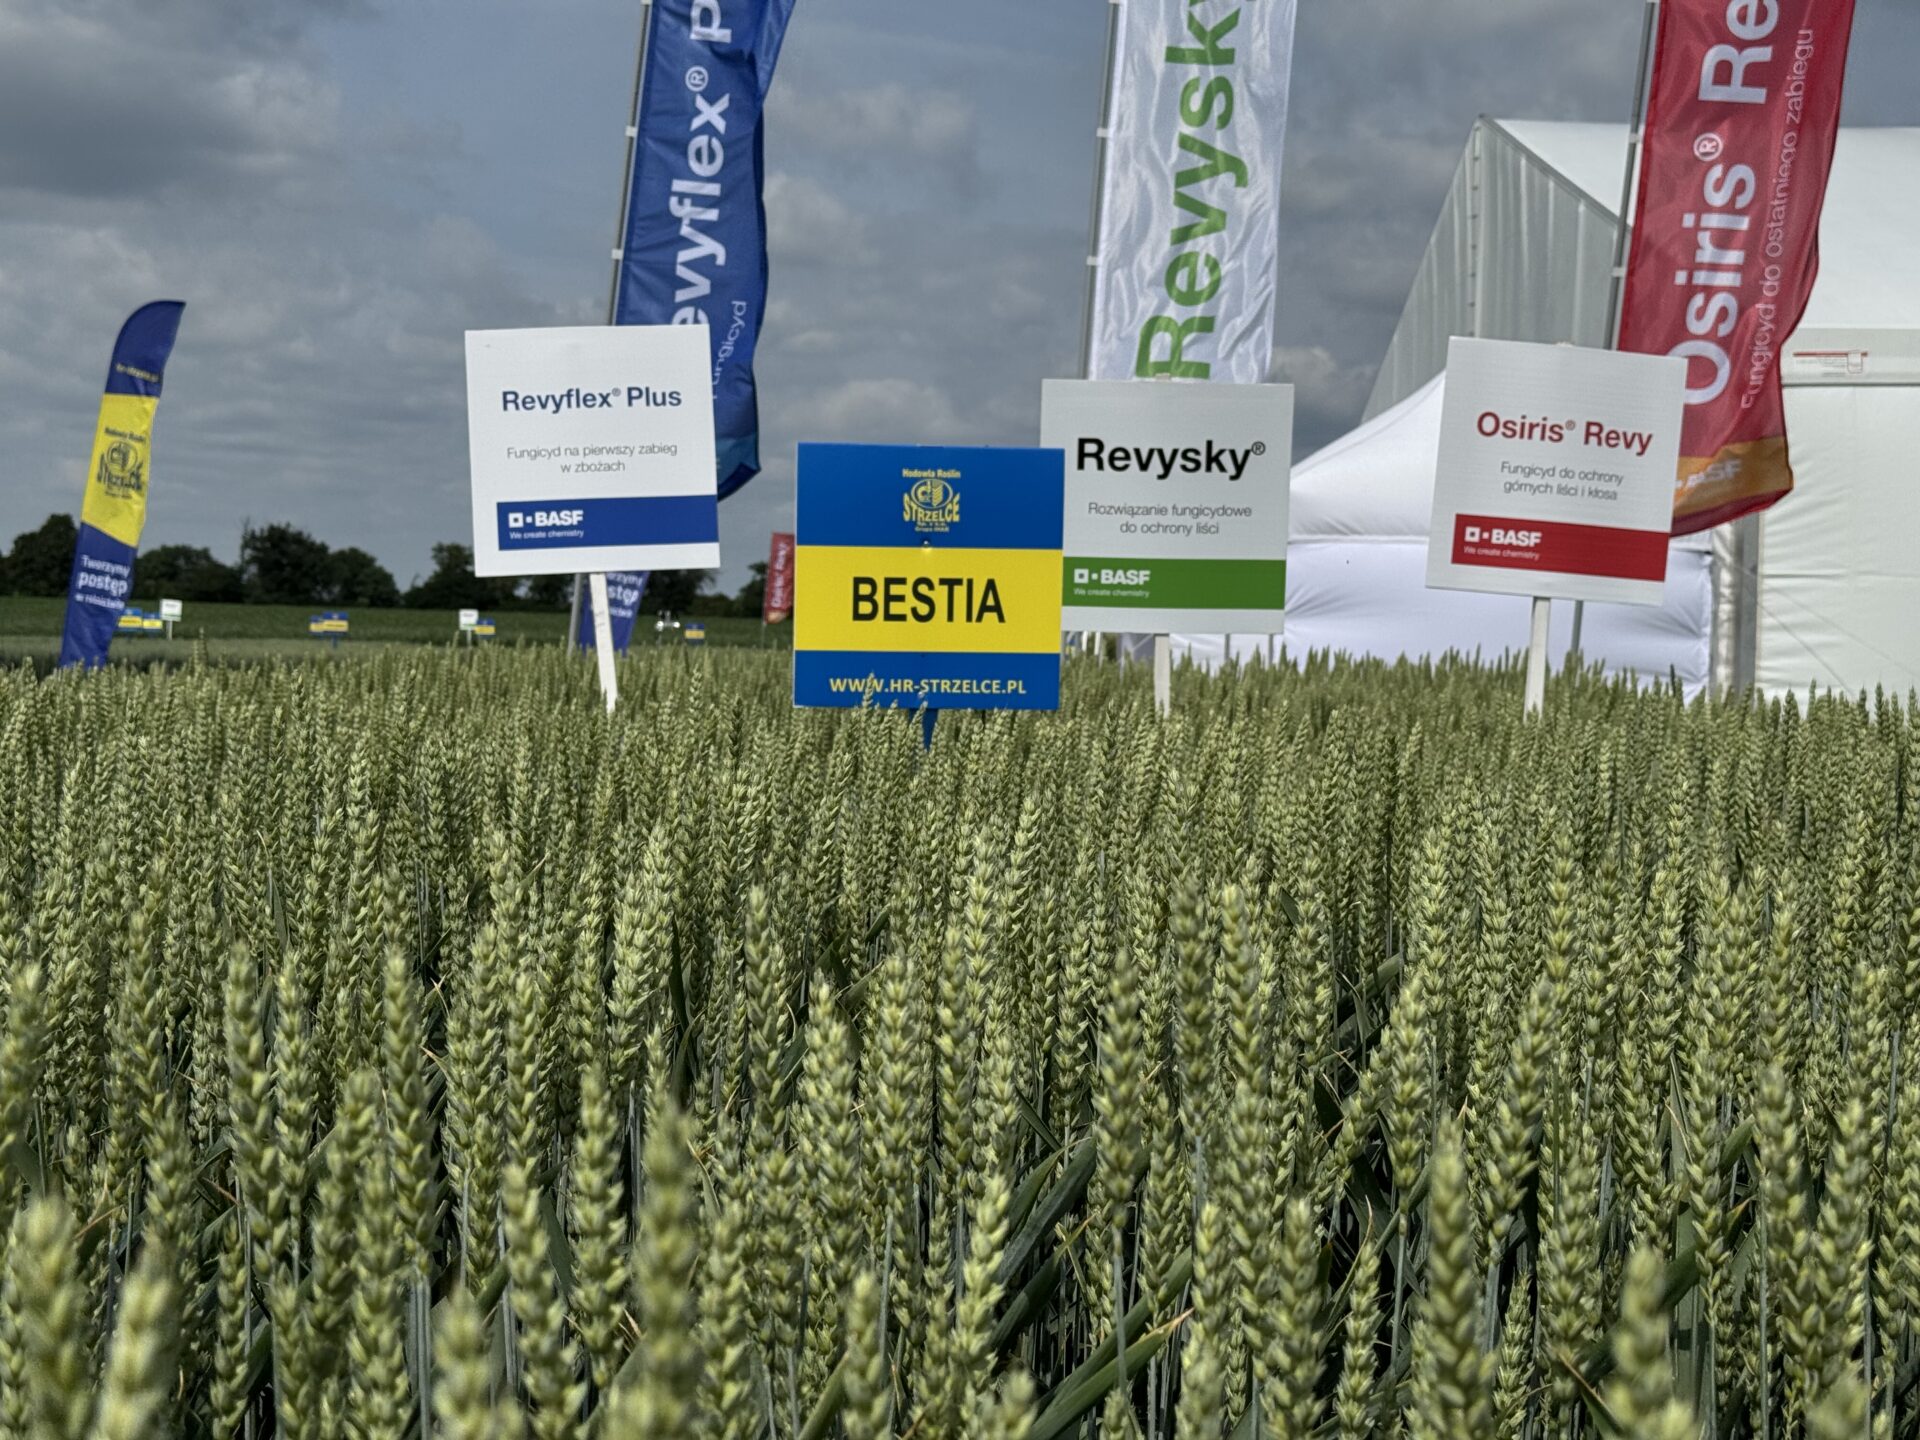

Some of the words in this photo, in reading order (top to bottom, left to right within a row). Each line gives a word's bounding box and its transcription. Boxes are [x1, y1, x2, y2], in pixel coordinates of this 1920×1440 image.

[1698, 0, 1779, 104] Re
[1784, 28, 1814, 124] zabiegu
[668, 66, 730, 325] vyflex®
[1135, 0, 1249, 379] Revysk
[1765, 131, 1797, 258] ostatniego
[1759, 264, 1780, 297] do
[502, 388, 621, 413] Revyflex®
[627, 386, 682, 407] Plus
[1477, 412, 1577, 443] Osiris®
[1583, 421, 1653, 456] Revy
[507, 445, 562, 461] Fungicyd
[564, 447, 580, 457] na
[583, 443, 636, 458] pierwszy
[638, 442, 678, 457] zabieg
[1077, 438, 1266, 481] Revysky®
[560, 463, 571, 474] w
[1501, 461, 1556, 480] Fungicyd
[1559, 467, 1575, 480] do
[1578, 470, 1624, 487] ochrony
[1503, 480, 1554, 497] górnych
[1556, 483, 1578, 497] liści
[534, 509, 584, 527] BASF
[903, 492, 960, 522] STRZELCE
[1088, 502, 1168, 519] Rozwiązanie
[1171, 504, 1252, 519] fungicydowe
[509, 531, 522, 540] We
[523, 531, 546, 539] create
[547, 529, 585, 539] chemistry
[1120, 522, 1137, 534] do
[1140, 523, 1193, 537] ochrony
[1196, 522, 1219, 535] liści
[1490, 528, 1542, 548] BASF
[1463, 546, 1476, 555] We
[1477, 547, 1501, 557] create
[1502, 549, 1540, 561] chemistry
[81, 554, 131, 579] Tworzymy
[1101, 569, 1151, 585] BASF
[78, 571, 128, 597] postęp
[1073, 588, 1086, 596] We
[1087, 588, 1111, 597] create
[1112, 589, 1150, 599] chemistry
[852, 576, 1006, 623] BESTIA
[829, 678, 1027, 694] WWW.HR-STRZELCE.PL
